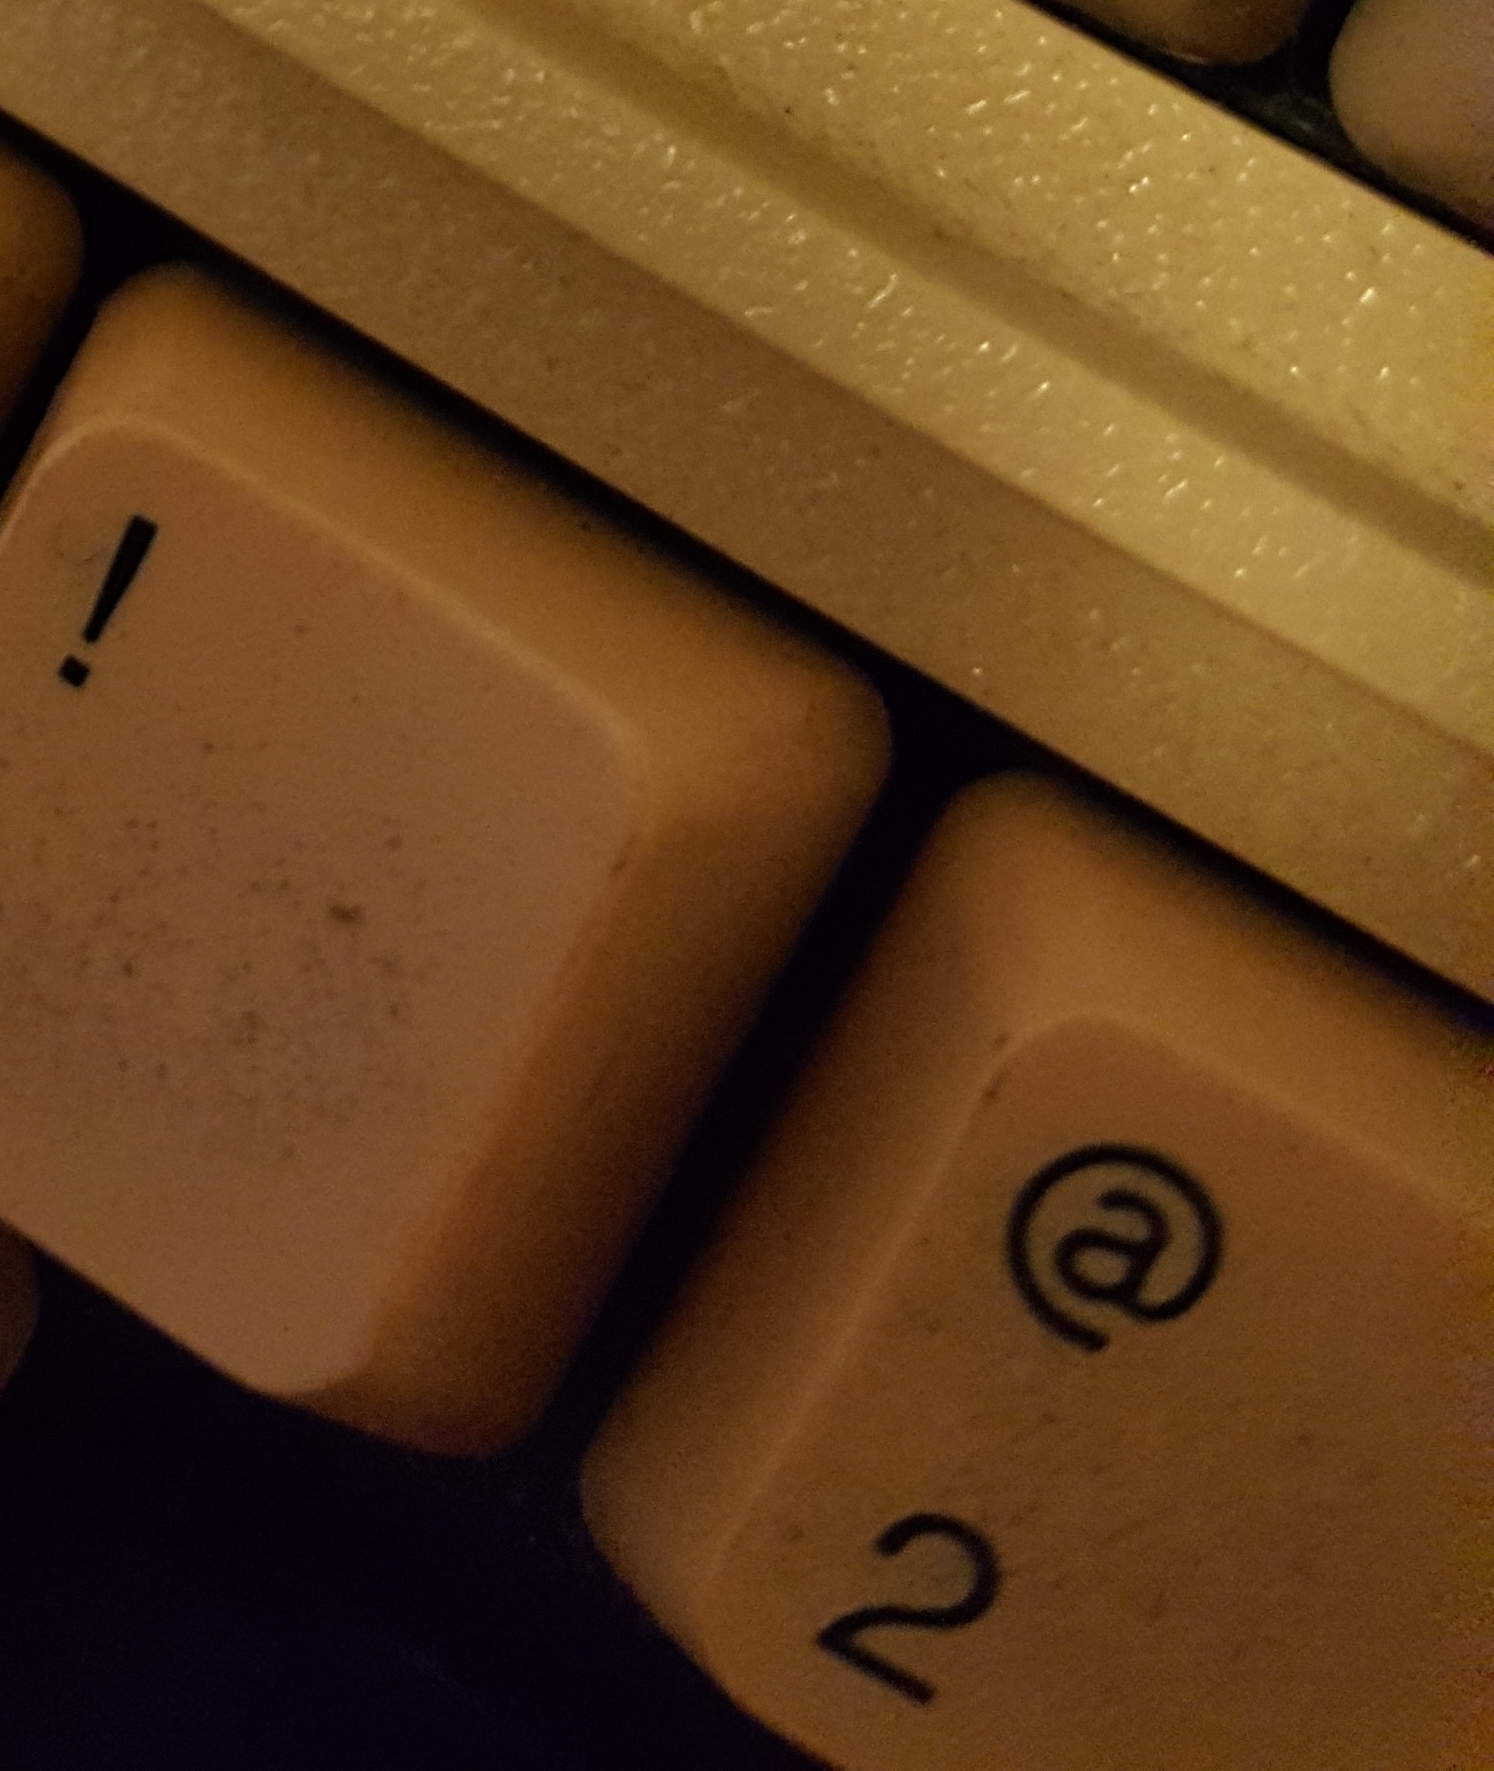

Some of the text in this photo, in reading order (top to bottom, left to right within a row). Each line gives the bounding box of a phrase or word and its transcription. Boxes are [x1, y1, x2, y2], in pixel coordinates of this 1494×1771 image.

[58, 515, 158, 689] !
[1006, 1143, 1222, 1352] @
[816, 1514, 1000, 1704] 2
